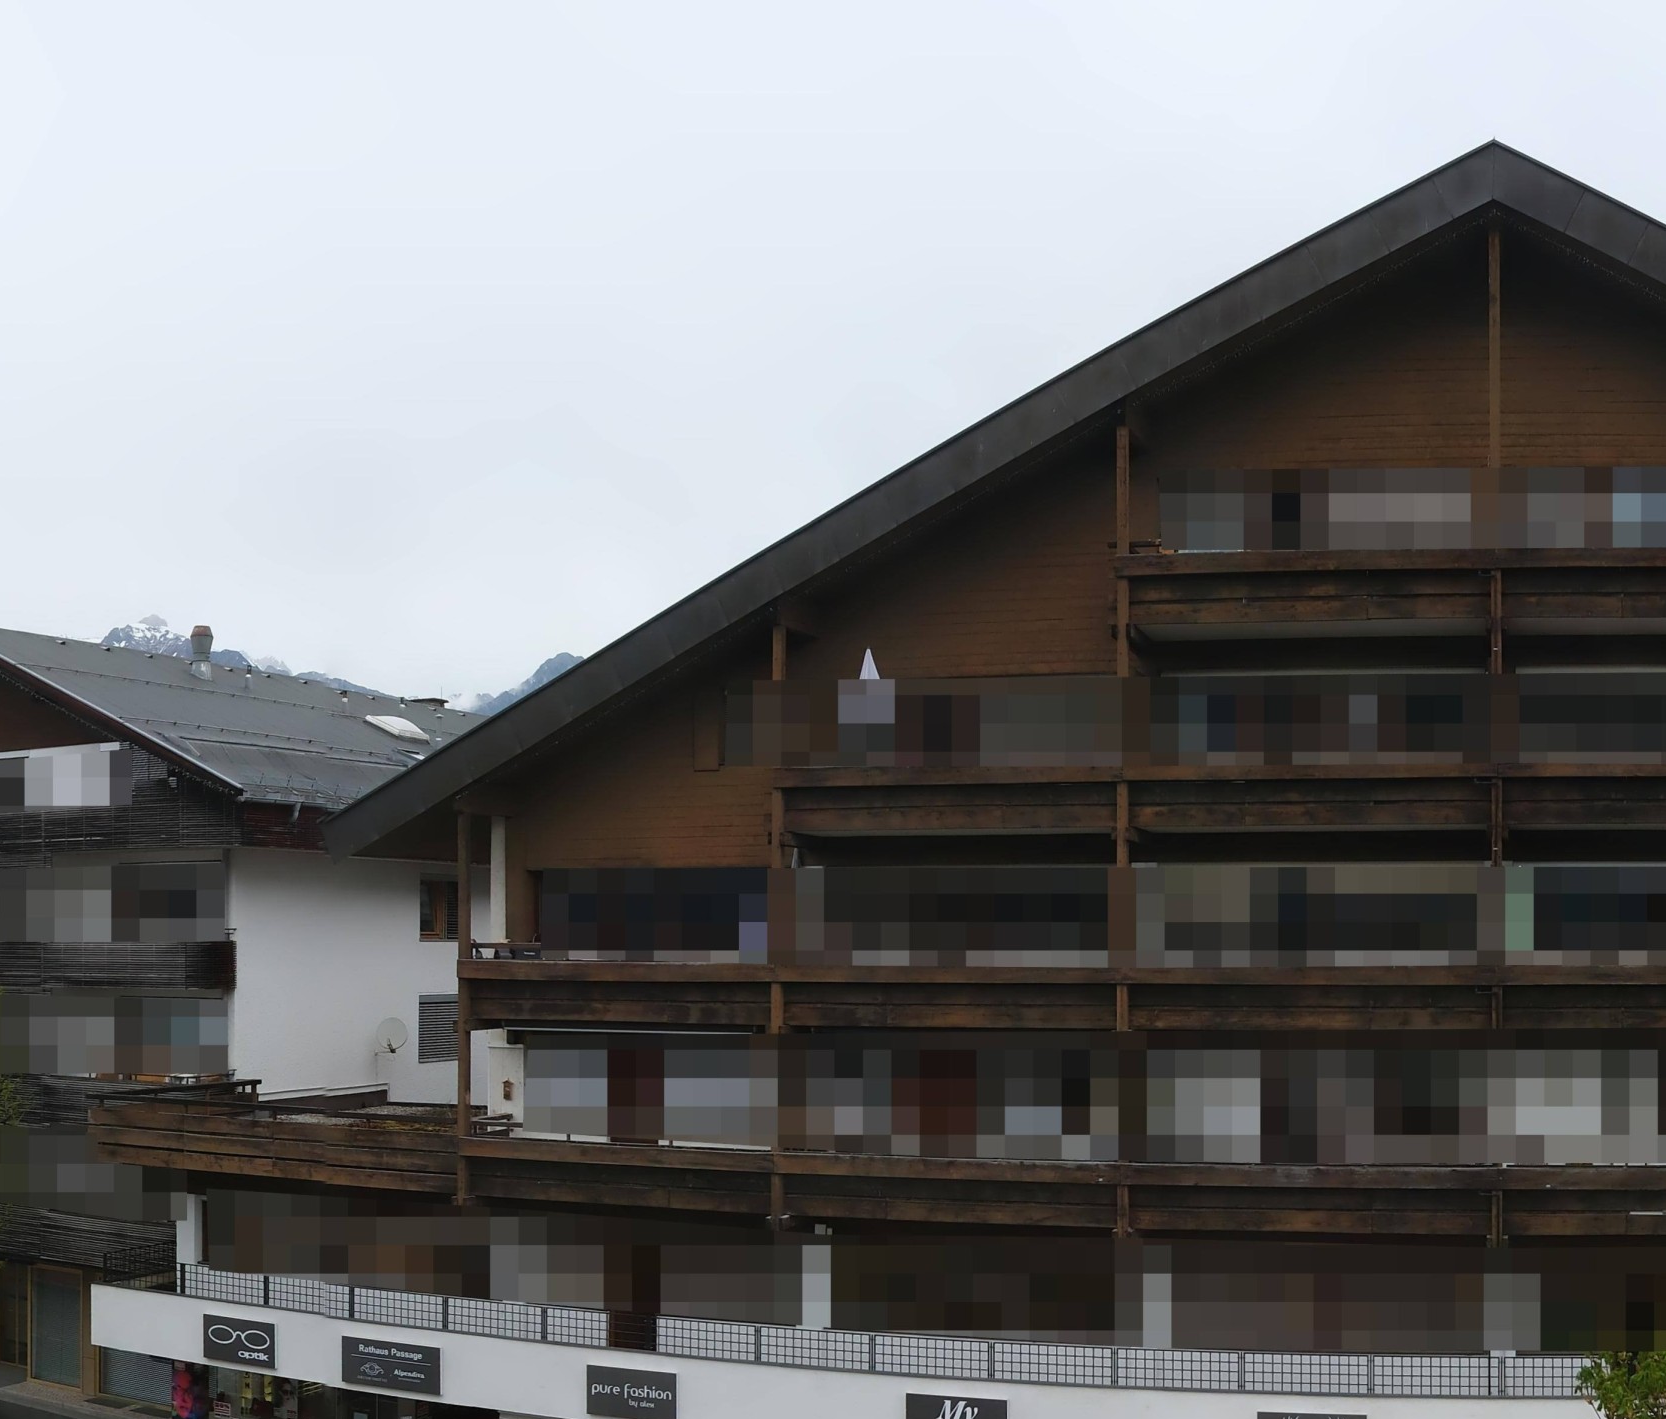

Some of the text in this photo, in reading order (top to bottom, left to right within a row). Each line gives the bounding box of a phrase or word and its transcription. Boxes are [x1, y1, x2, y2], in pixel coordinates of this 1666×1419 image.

[238, 1350, 269, 1362] optik
[359, 1344, 423, 1360] Rathaus Passage
[591, 1382, 672, 1400] pure fashion
[629, 1399, 639, 1408] by
